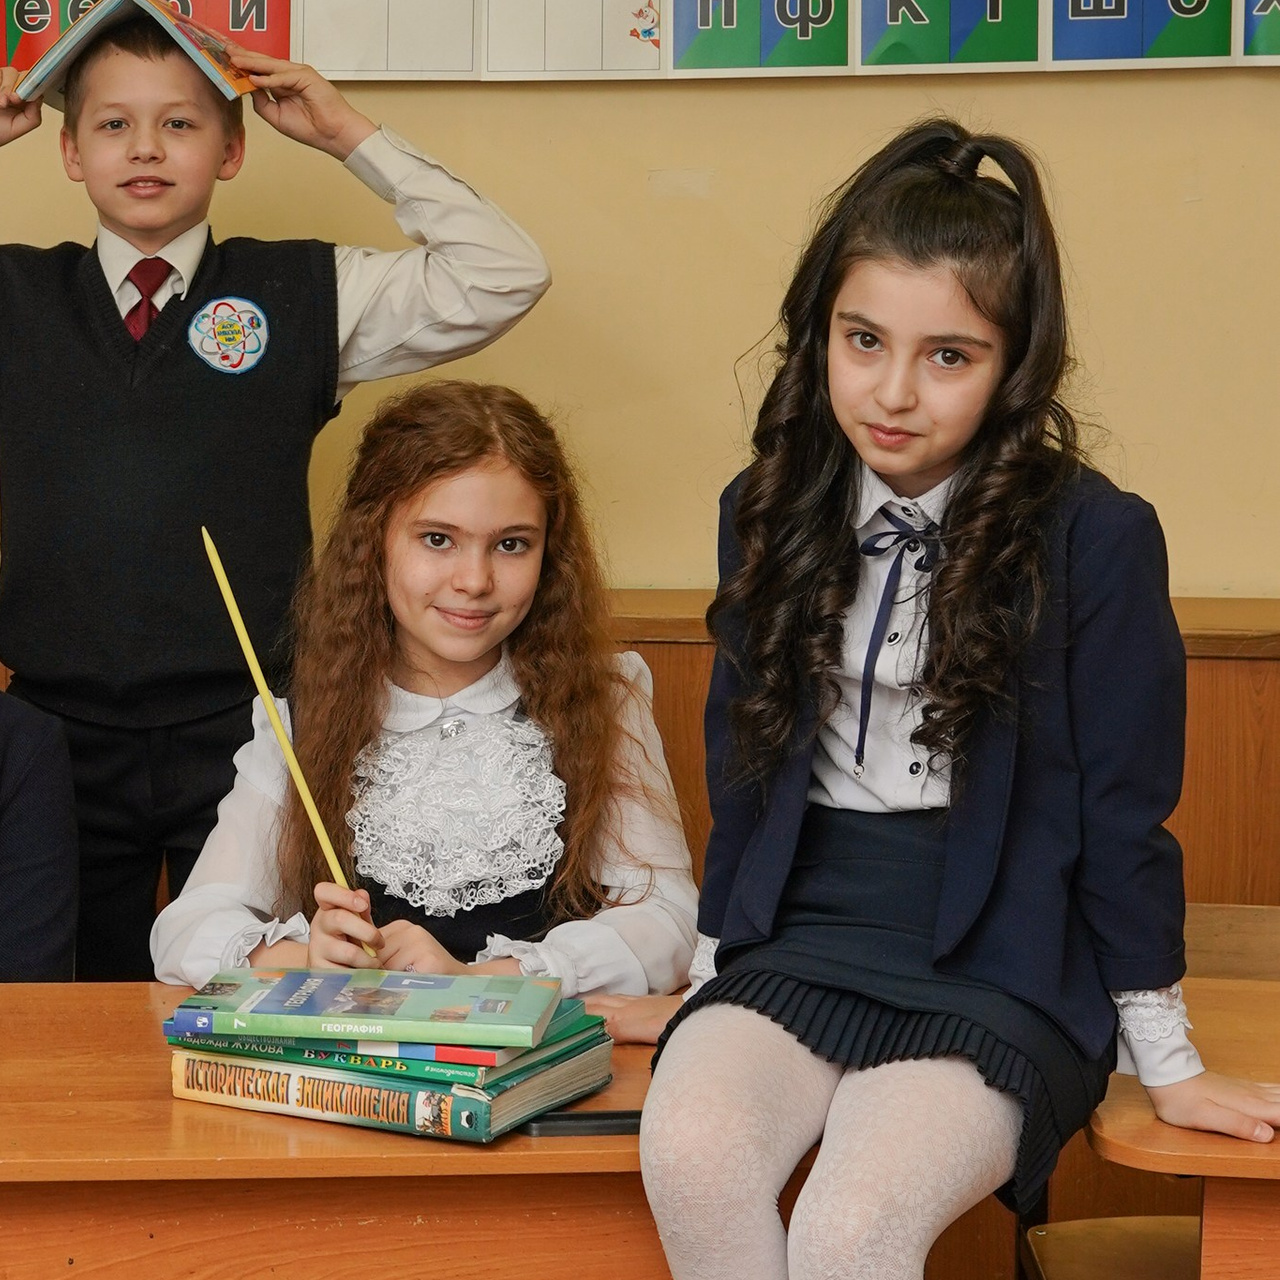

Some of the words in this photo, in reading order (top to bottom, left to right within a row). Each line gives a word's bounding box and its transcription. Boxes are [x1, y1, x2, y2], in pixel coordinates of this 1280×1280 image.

[234, 1018, 246, 1029] 7
[321, 1023, 383, 1034] ГЕОГРАФИЯ
[238, 1035, 296, 1046] ОБЩЕСТВОЗНАНИЕ
[231, 1041, 284, 1055] ЖУКОВА
[303, 1049, 408, 1071] БУКВАРЬ
[184, 1058, 291, 1105] ИСТОРИЧЕСКАЯ
[295, 1075, 410, 1125] ЭНЦИКЛОПЕДИЯ
